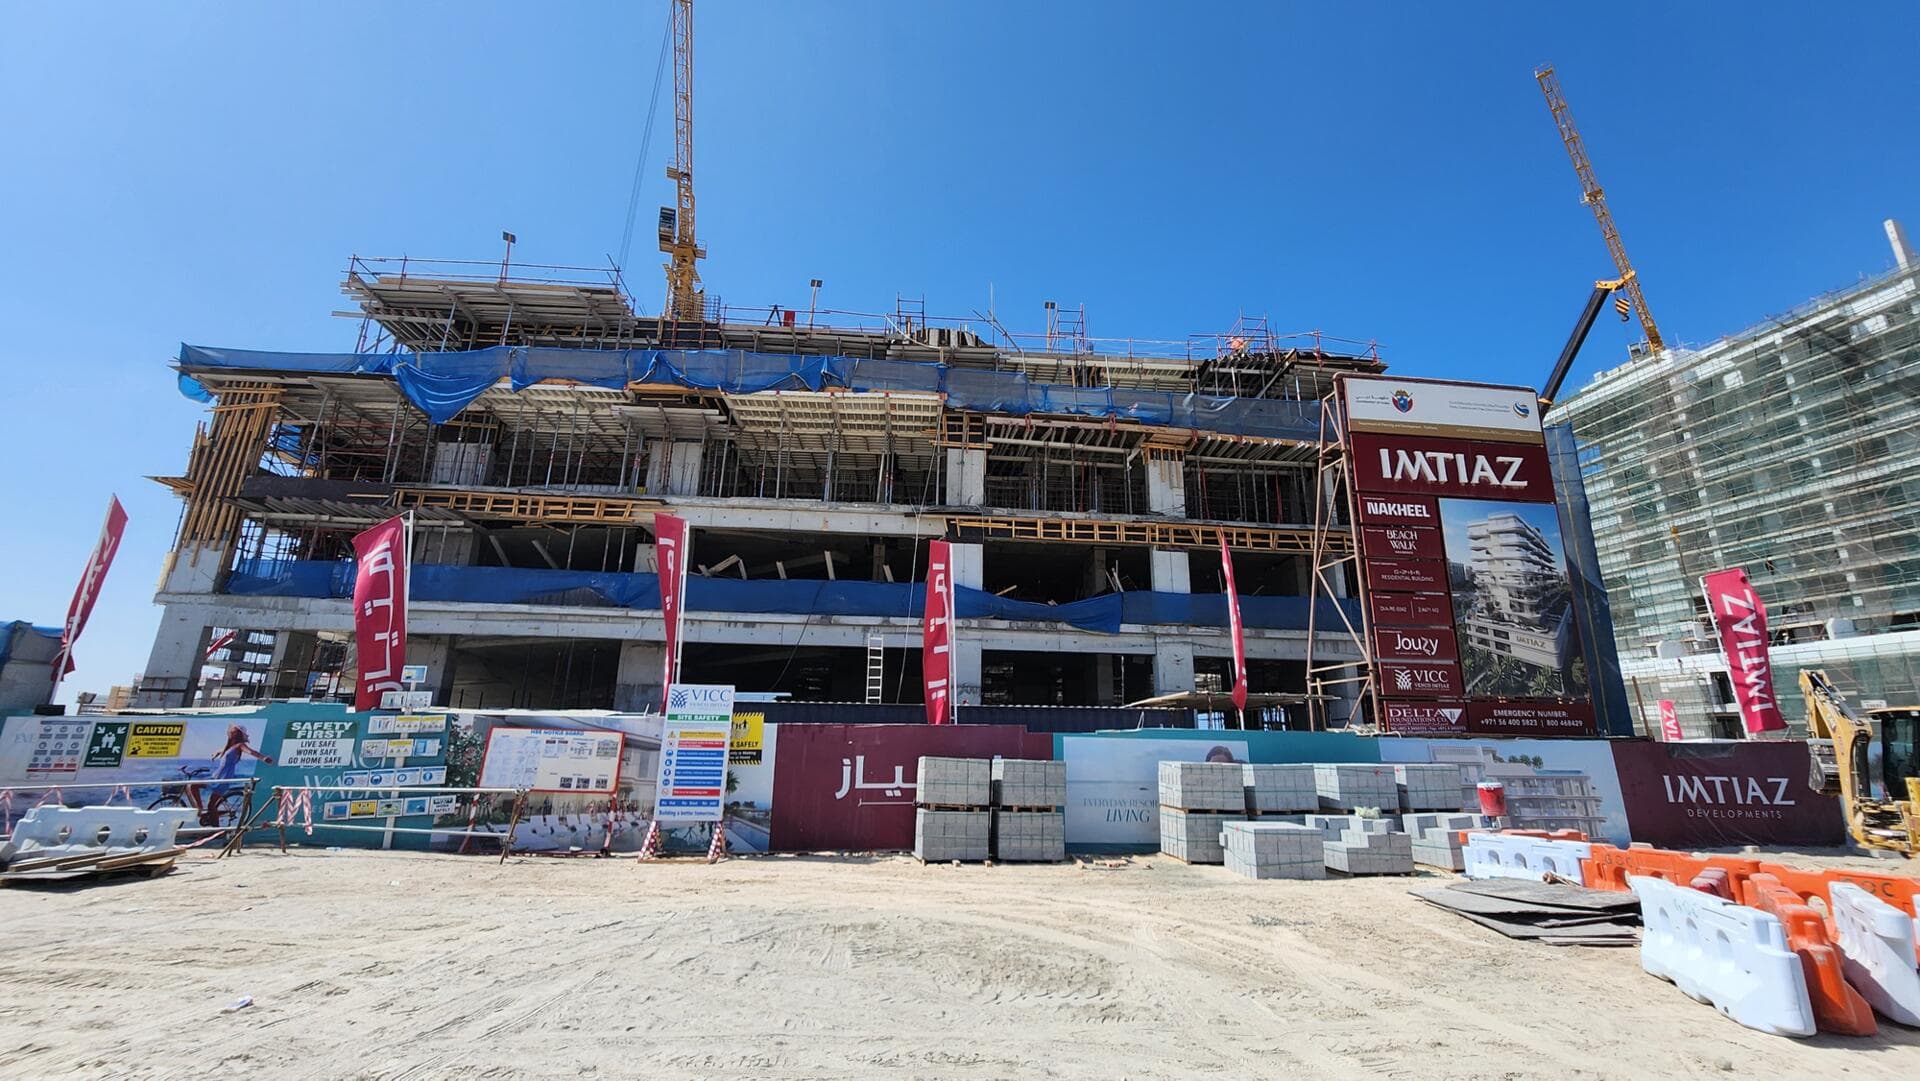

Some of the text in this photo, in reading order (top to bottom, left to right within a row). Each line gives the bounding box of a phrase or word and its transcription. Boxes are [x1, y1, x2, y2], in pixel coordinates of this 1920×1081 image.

[1379, 448, 1528, 487] IMTIAZ
[1366, 501, 1431, 518] NAKHEEL
[1386, 529, 1418, 540] BEACH
[1390, 540, 1417, 550] WALK
[1394, 633, 1438, 656] Jouzy
[1721, 589, 1774, 713] IMTIAZ
[1413, 670, 1448, 683] VICC
[691, 688, 731, 702] VICC
[1389, 708, 1445, 717] DELTA
[1493, 709, 1568, 718] EMERGENCY NUMBER:
[291, 721, 353, 730] SAFETY
[1508, 718, 1521, 726] 400
[1664, 708, 1679, 741] TIAZ
[136, 726, 182, 734] CAUTION
[296, 730, 345, 738] FIRST
[1663, 775, 1795, 805] IMTIAZ
[1105, 808, 1150, 823] LIVING
[1687, 808, 1782, 819] DEVELOPMENTS
